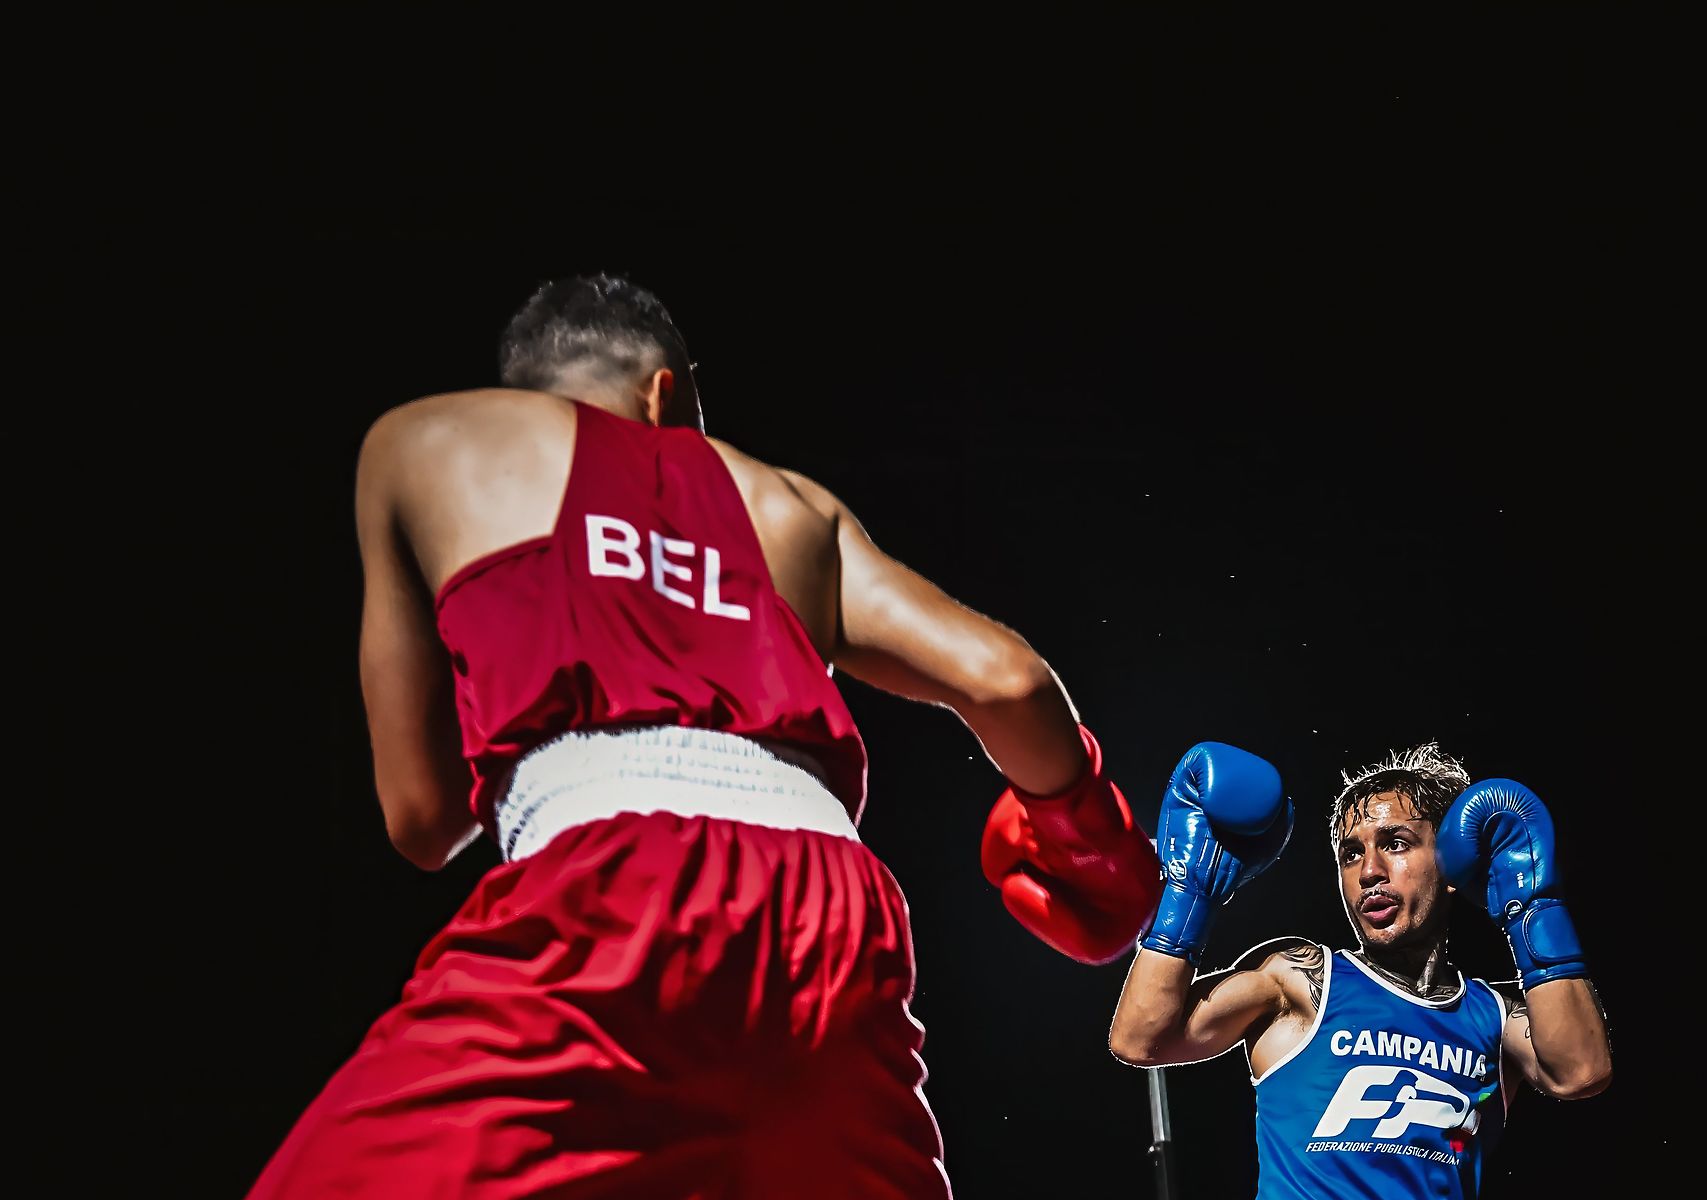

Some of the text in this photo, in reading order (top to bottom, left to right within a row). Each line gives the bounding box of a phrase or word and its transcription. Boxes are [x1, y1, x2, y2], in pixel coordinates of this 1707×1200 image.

[585, 514, 750, 621] BEL
[1330, 1029, 1487, 1081] CAMPANIA
[1305, 1141, 1375, 1153] FEDERAZIONE
[1373, 1143, 1430, 1159] PUGILISTICA
